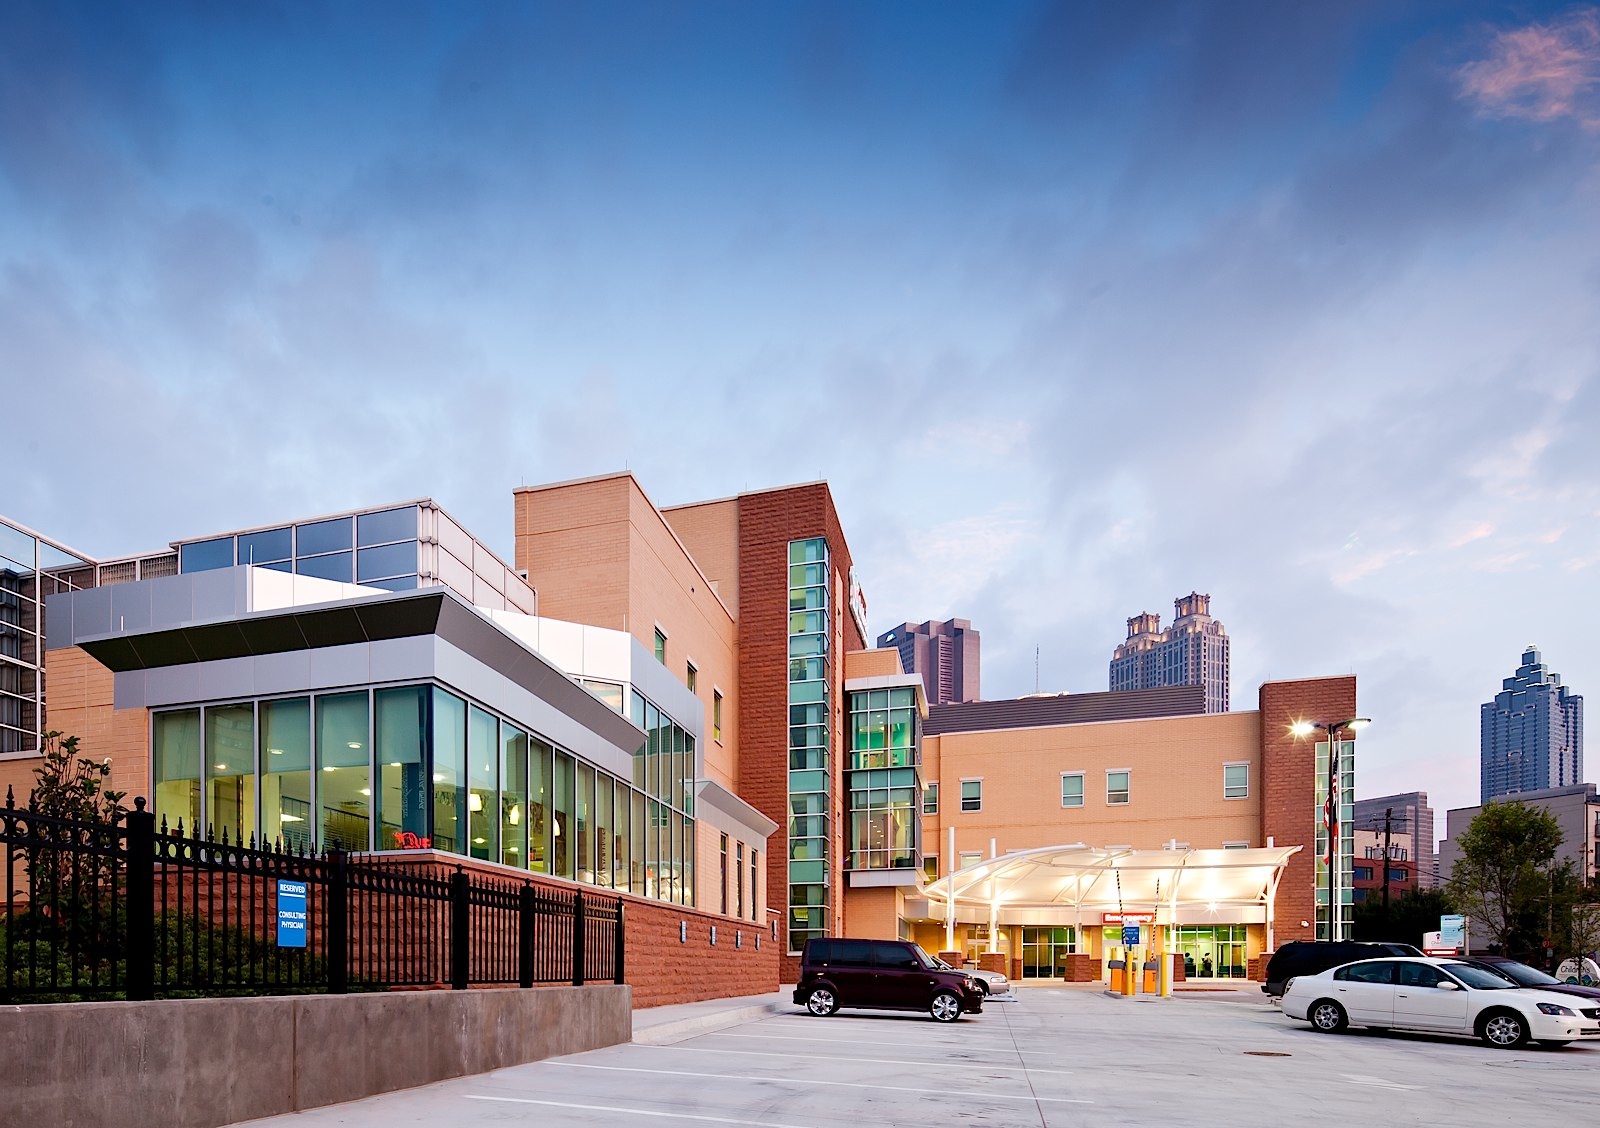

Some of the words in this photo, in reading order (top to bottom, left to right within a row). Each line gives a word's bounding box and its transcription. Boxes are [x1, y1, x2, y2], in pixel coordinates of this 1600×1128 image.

[280, 884, 306, 893] RESERVED
[279, 911, 306, 919] CONSULTING
[281, 921, 304, 929] PHYSICIAN
